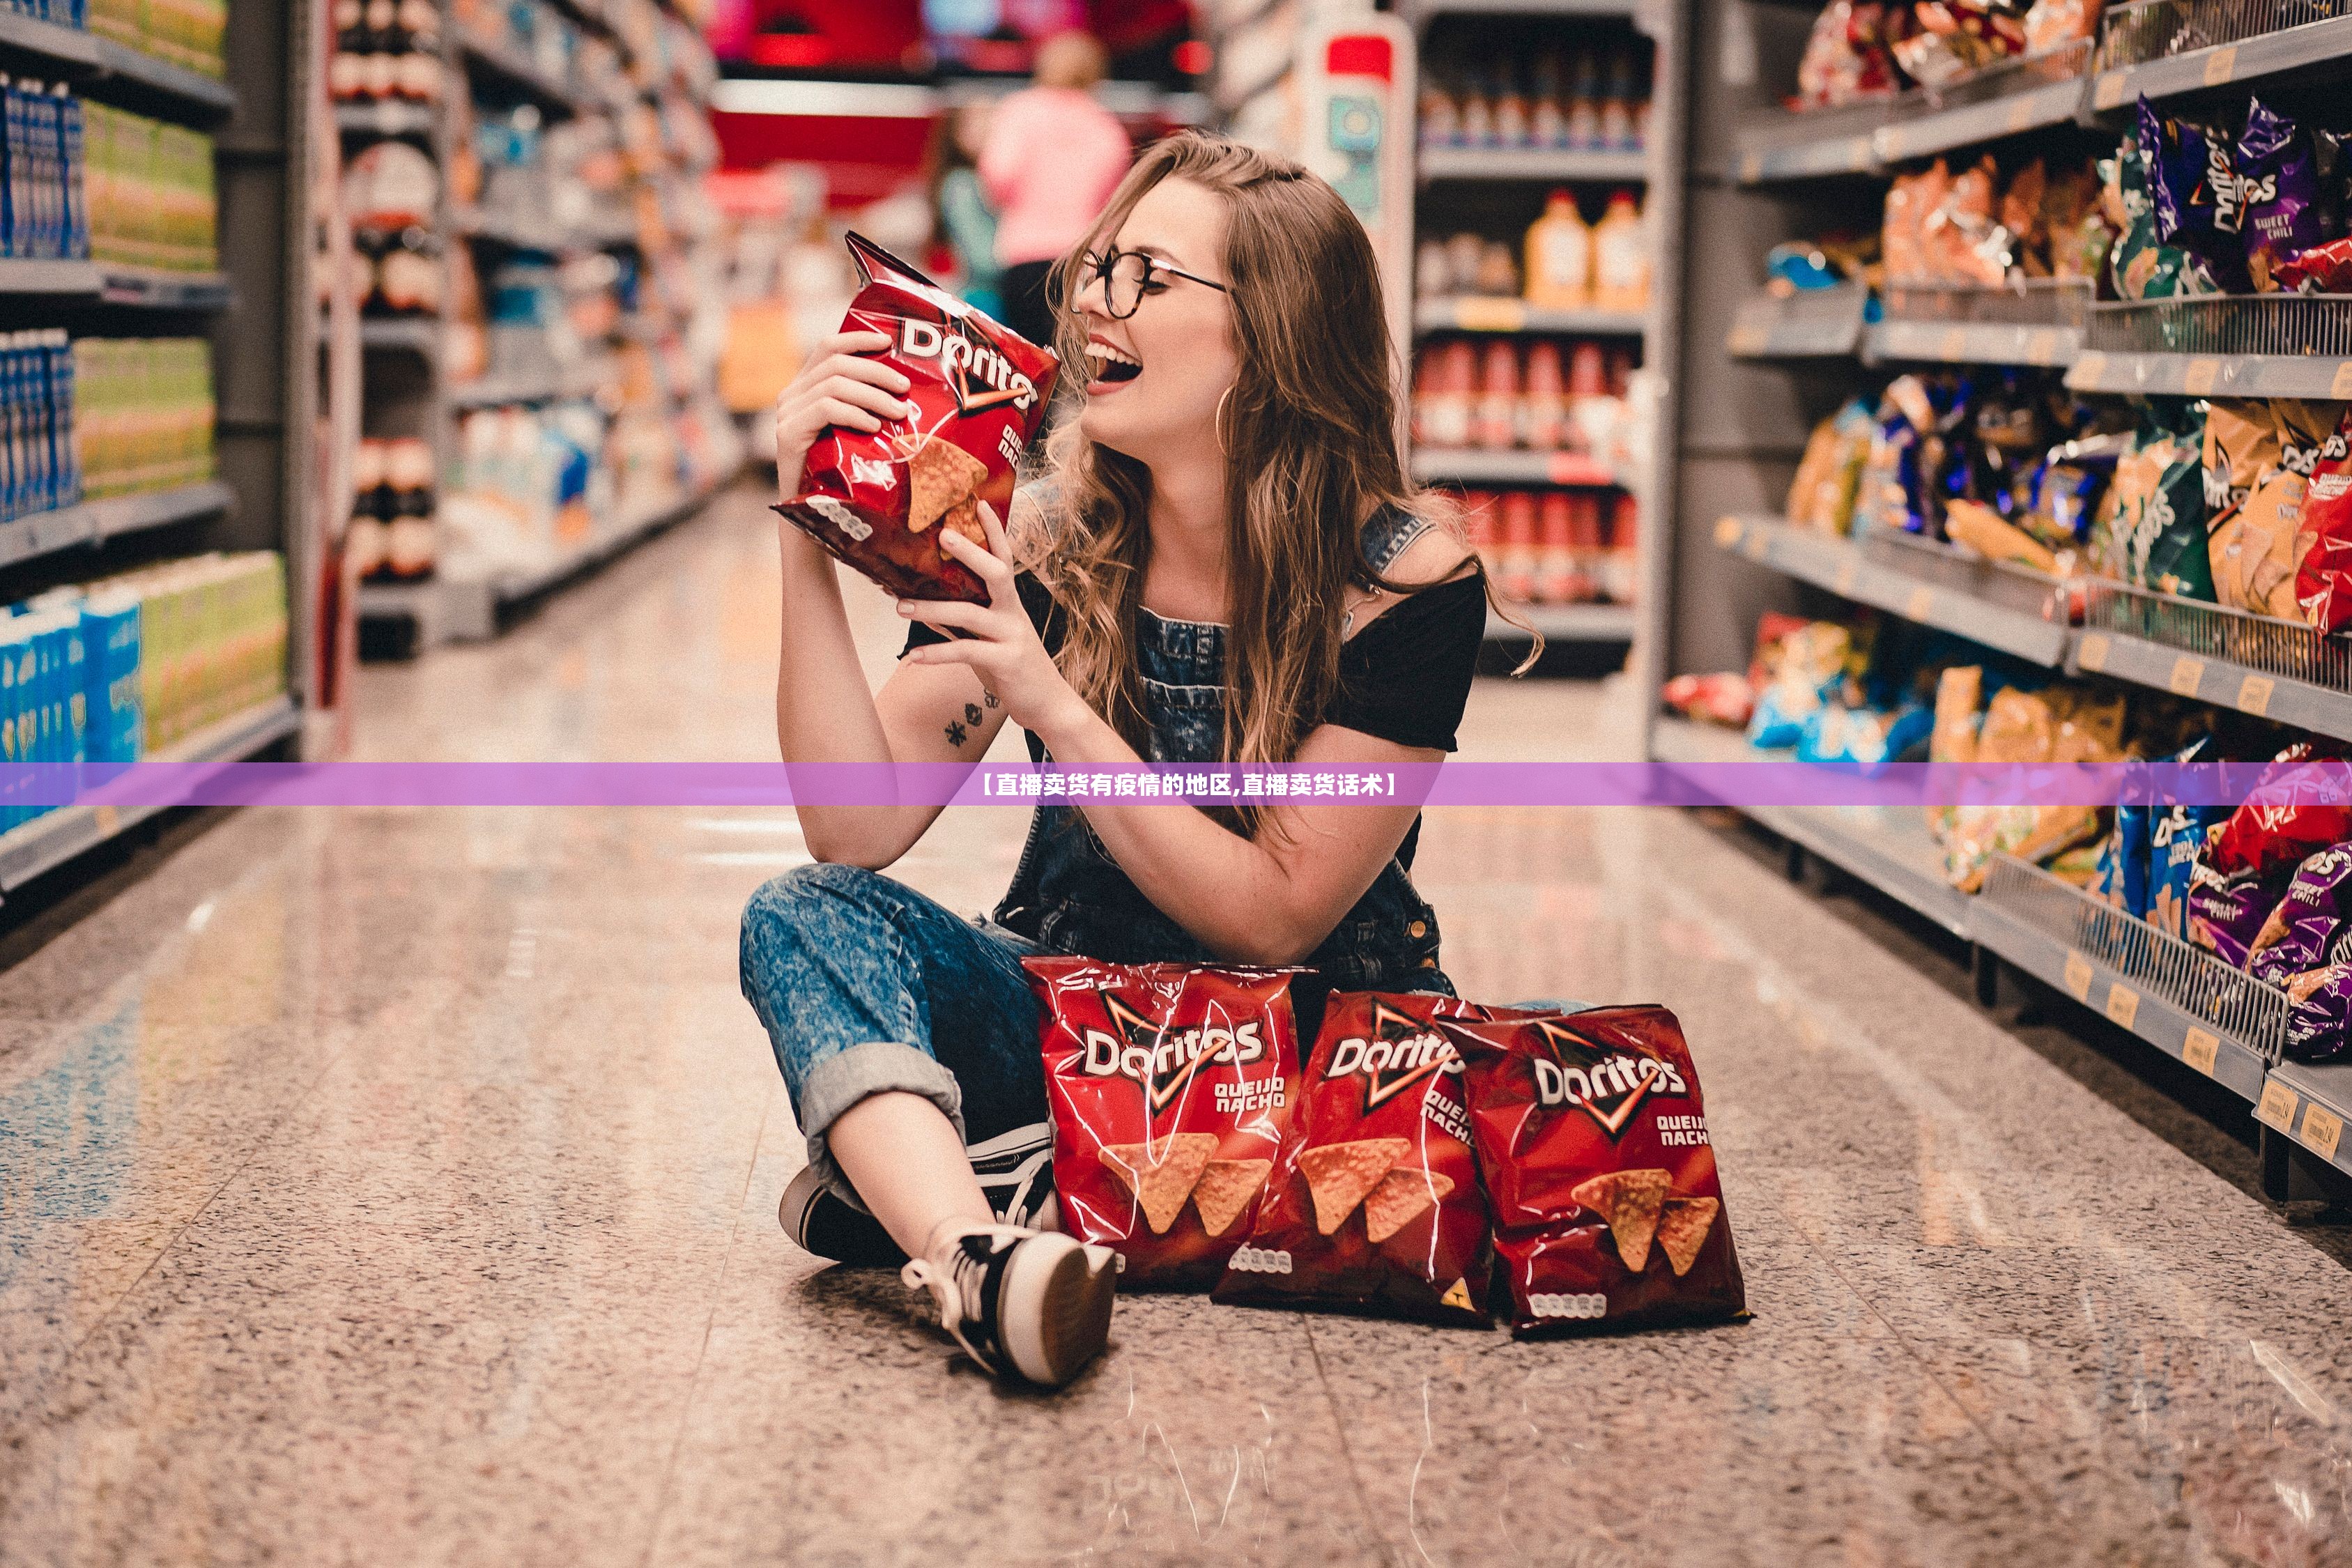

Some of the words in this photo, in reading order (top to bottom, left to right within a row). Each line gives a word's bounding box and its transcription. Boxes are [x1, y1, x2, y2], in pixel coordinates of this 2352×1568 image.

[1084, 1022, 1263, 1077] Doritos
[1328, 1033, 1467, 1077] Dorito
[1214, 1077, 1285, 1098] QUEIJO
[1535, 1055, 1686, 1105] Doritos
[1216, 1092, 1286, 1113] NACHO
[1661, 1130, 1709, 1146] NACH
